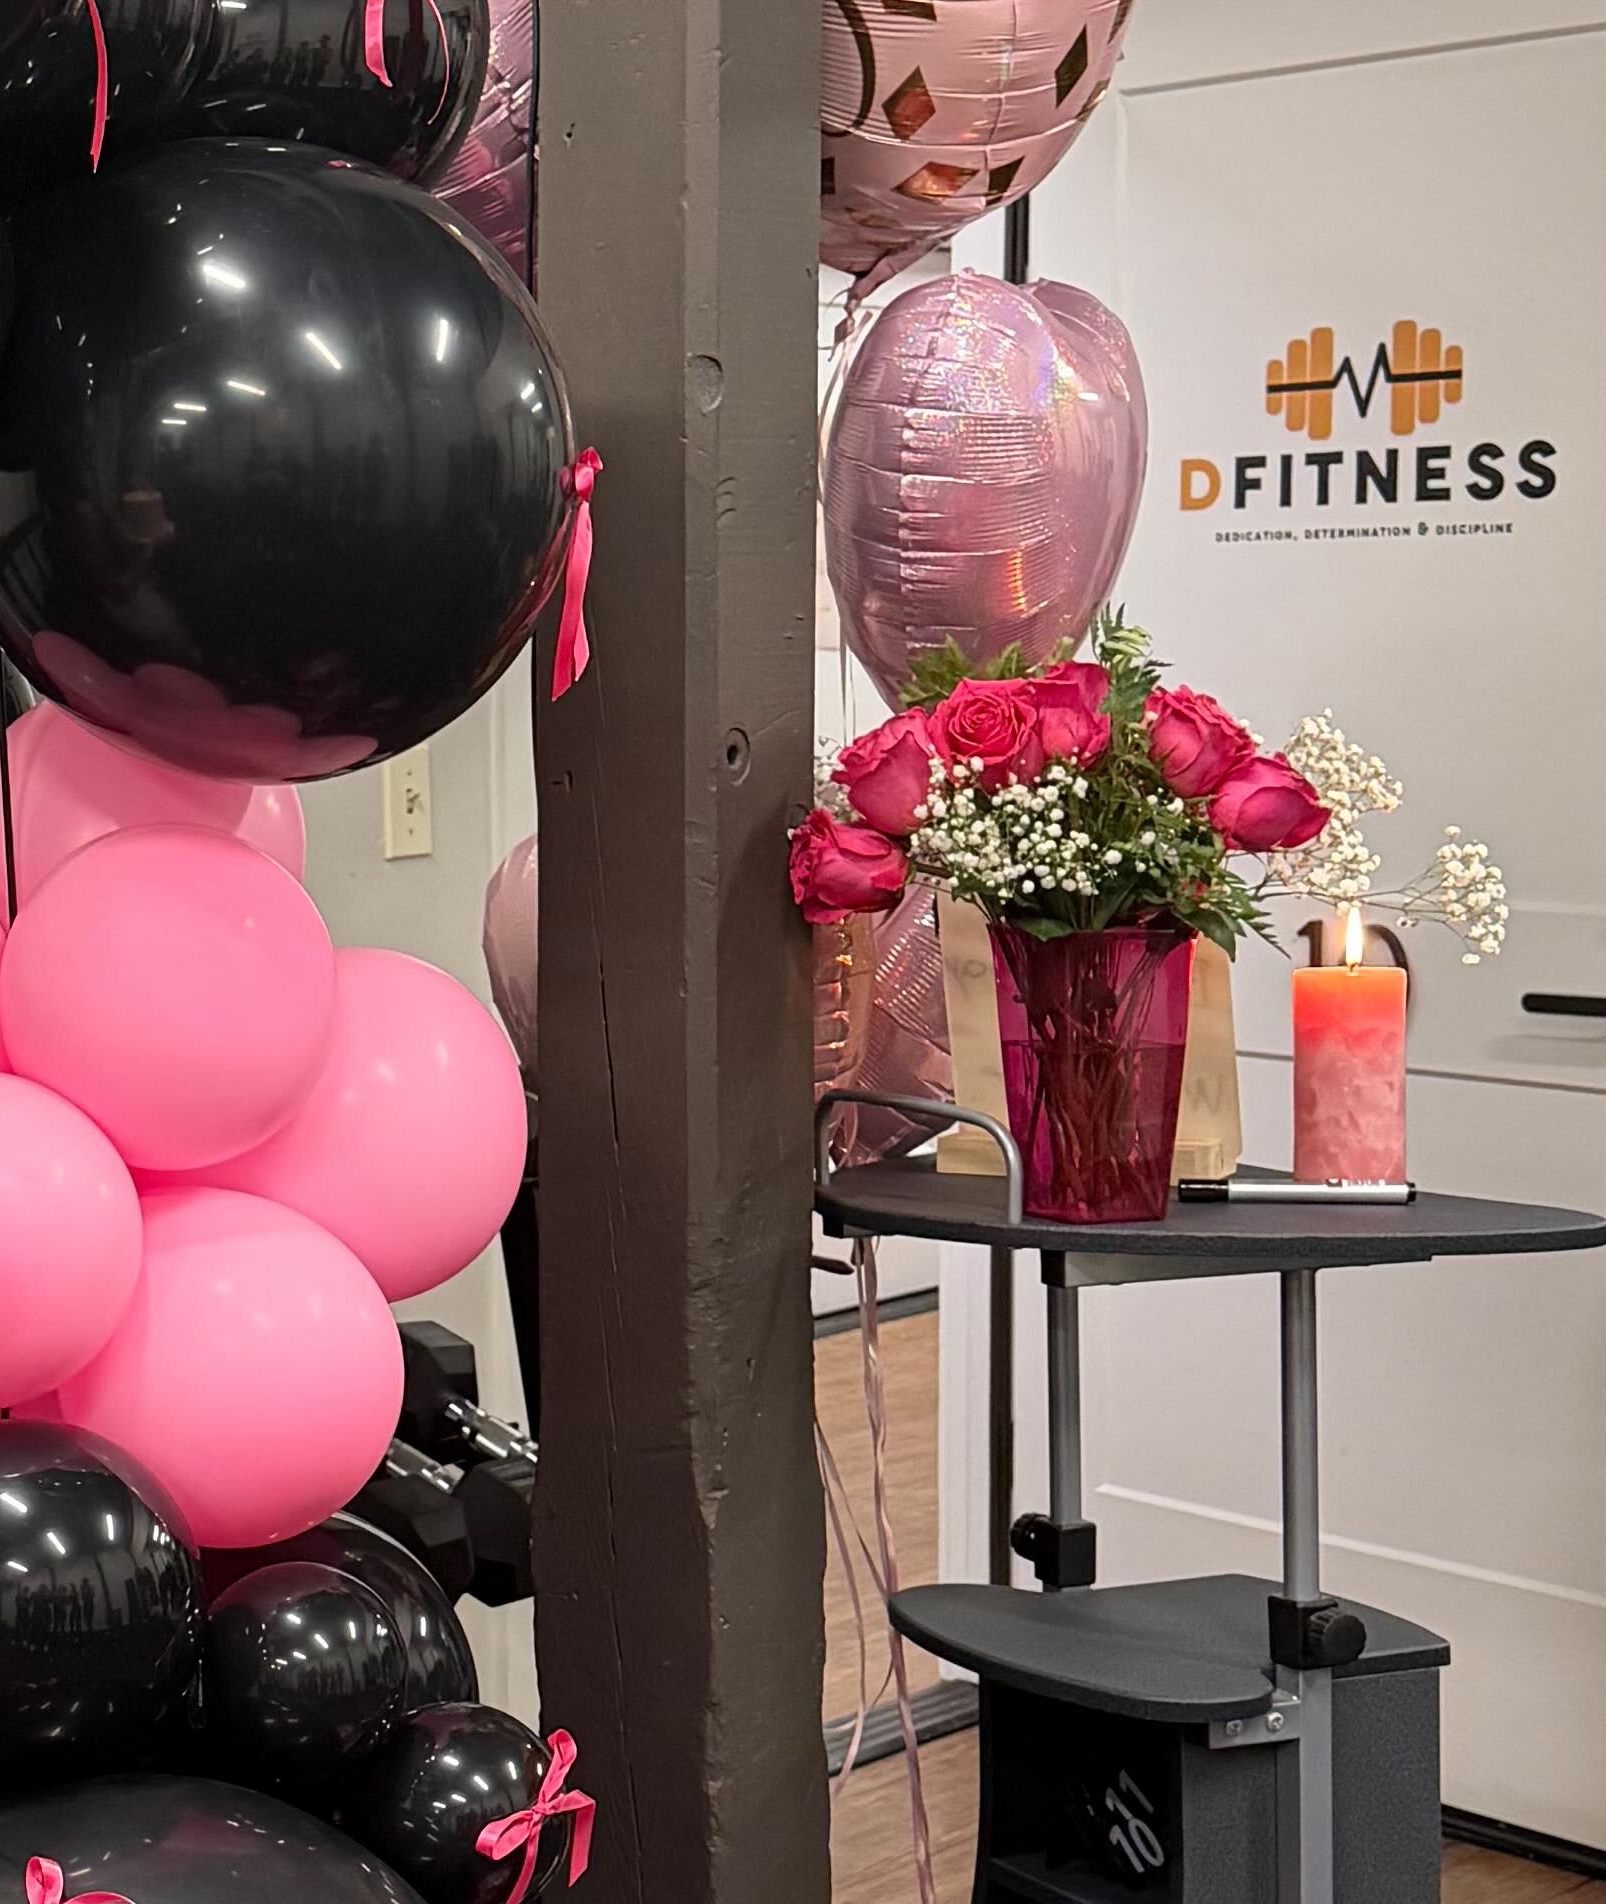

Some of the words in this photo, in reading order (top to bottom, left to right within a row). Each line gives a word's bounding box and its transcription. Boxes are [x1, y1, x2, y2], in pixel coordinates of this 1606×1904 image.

[1179, 439, 1557, 512] DFITNESS
[1214, 531, 1299, 544] DEDICATION,
[1304, 525, 1412, 541] DETERMINATION
[1417, 521, 1430, 536] &
[1435, 522, 1514, 536] DISCIPLINE
[1109, 1816, 1165, 1874] 10
